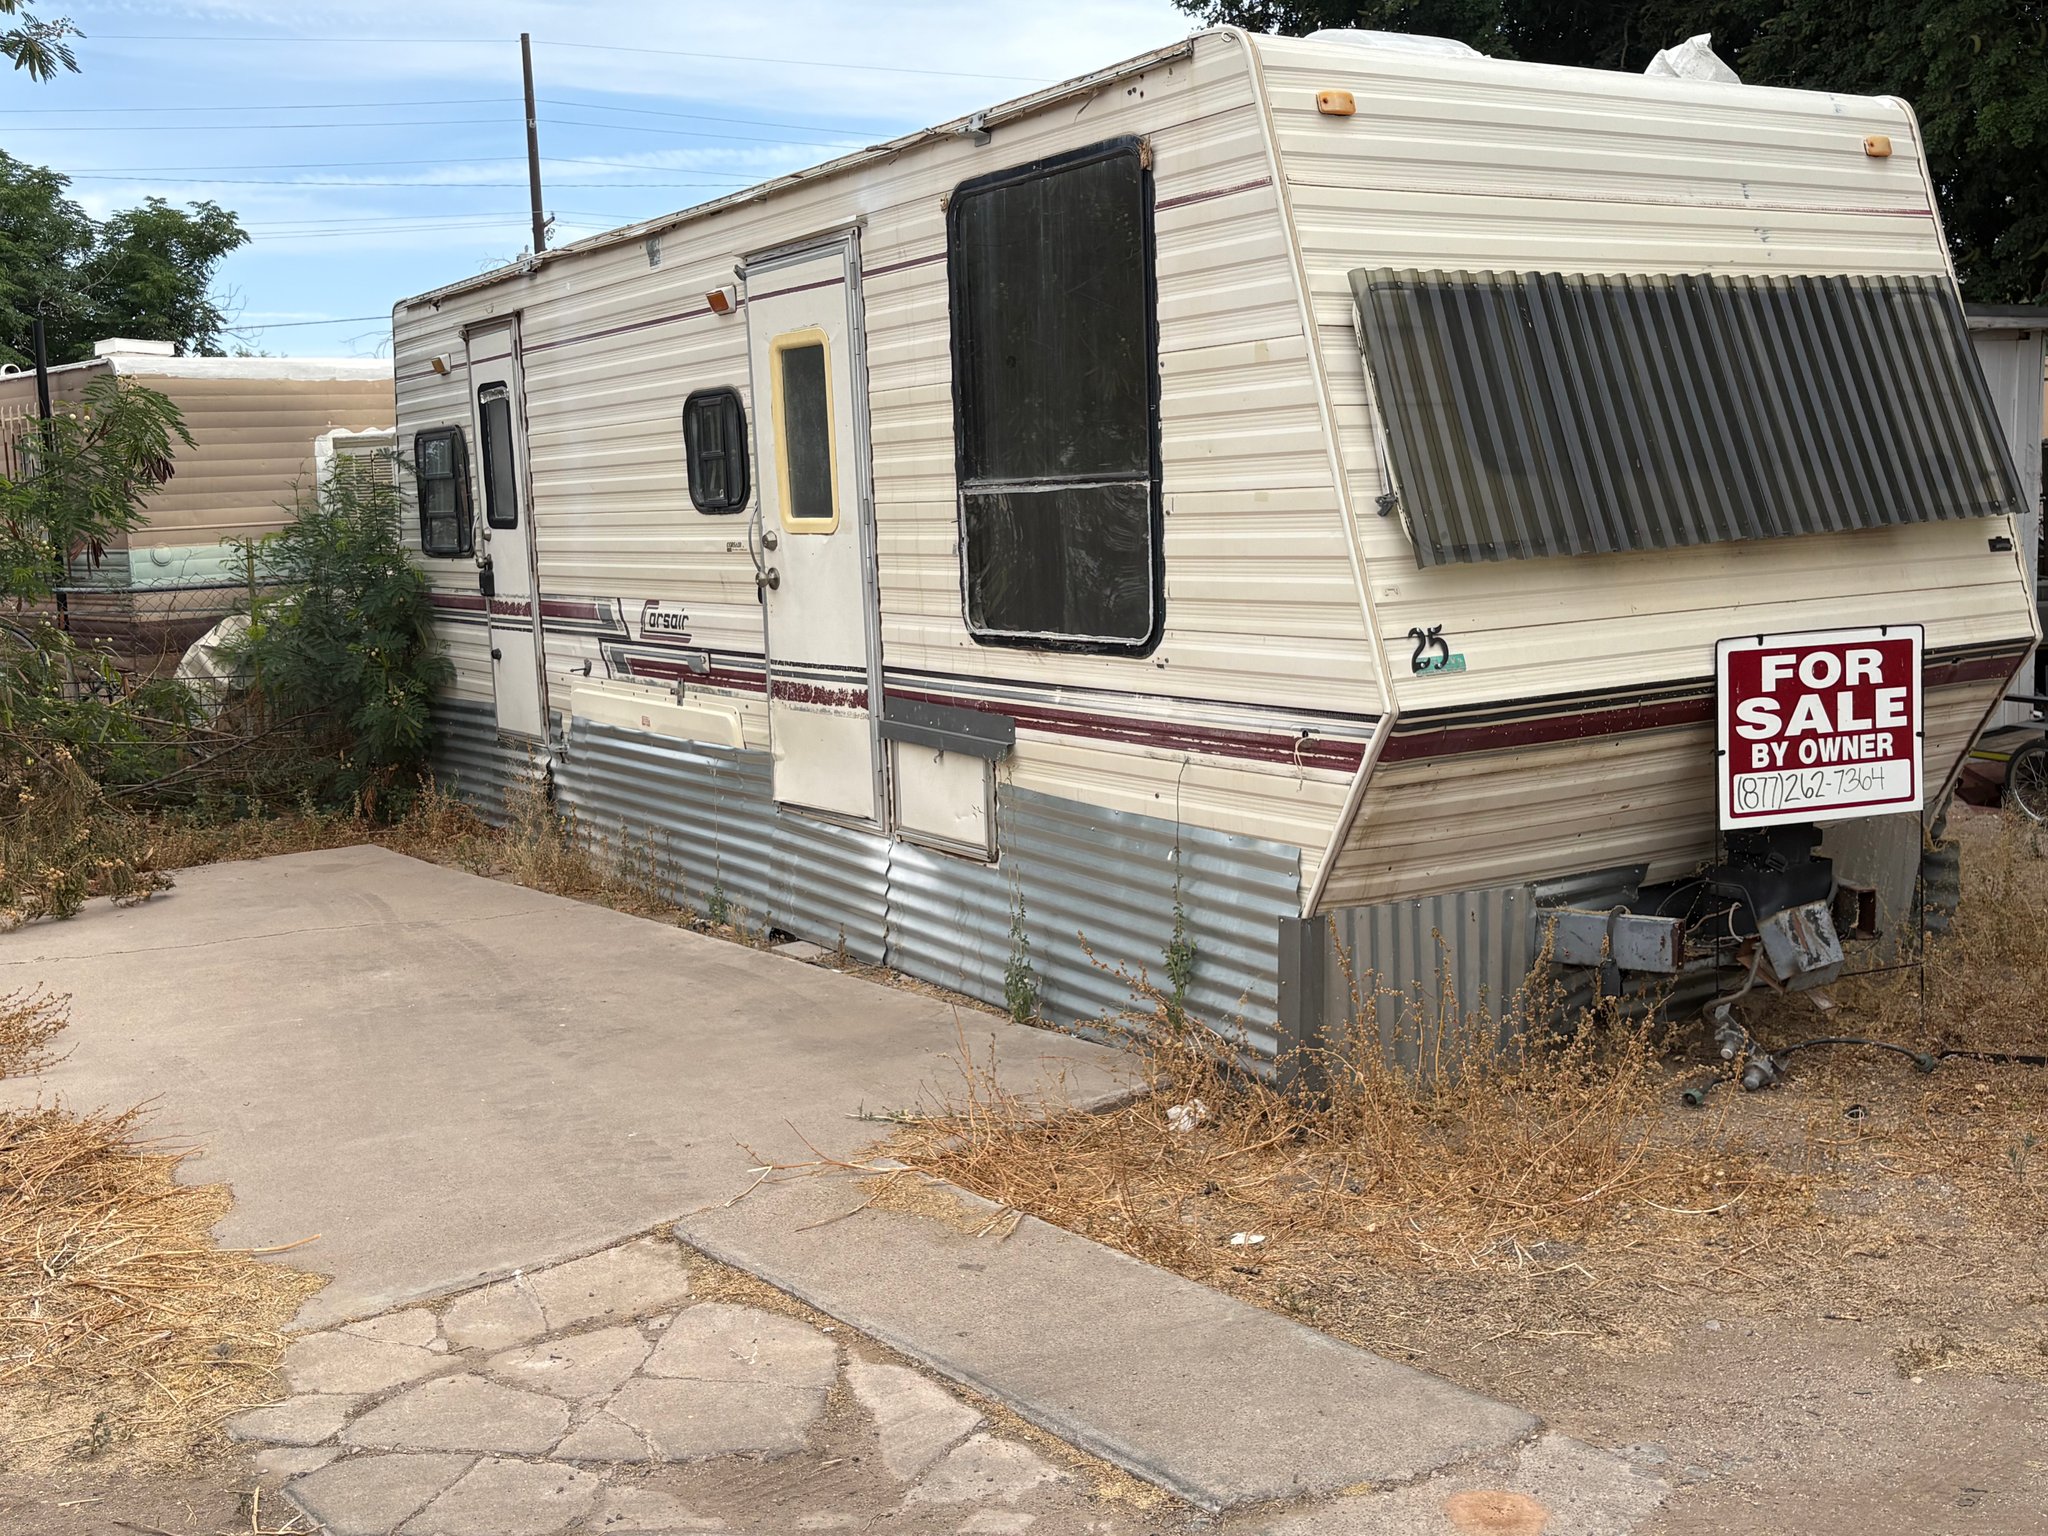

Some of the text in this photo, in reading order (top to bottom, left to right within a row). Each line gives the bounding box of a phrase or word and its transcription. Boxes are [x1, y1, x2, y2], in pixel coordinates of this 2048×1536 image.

[640, 599, 692, 644] Corsair
[1407, 623, 1449, 674] 25
[1761, 648, 1884, 693] FOR
[1735, 686, 1908, 740] SALE
[1751, 732, 1894, 769] BY OWNER
